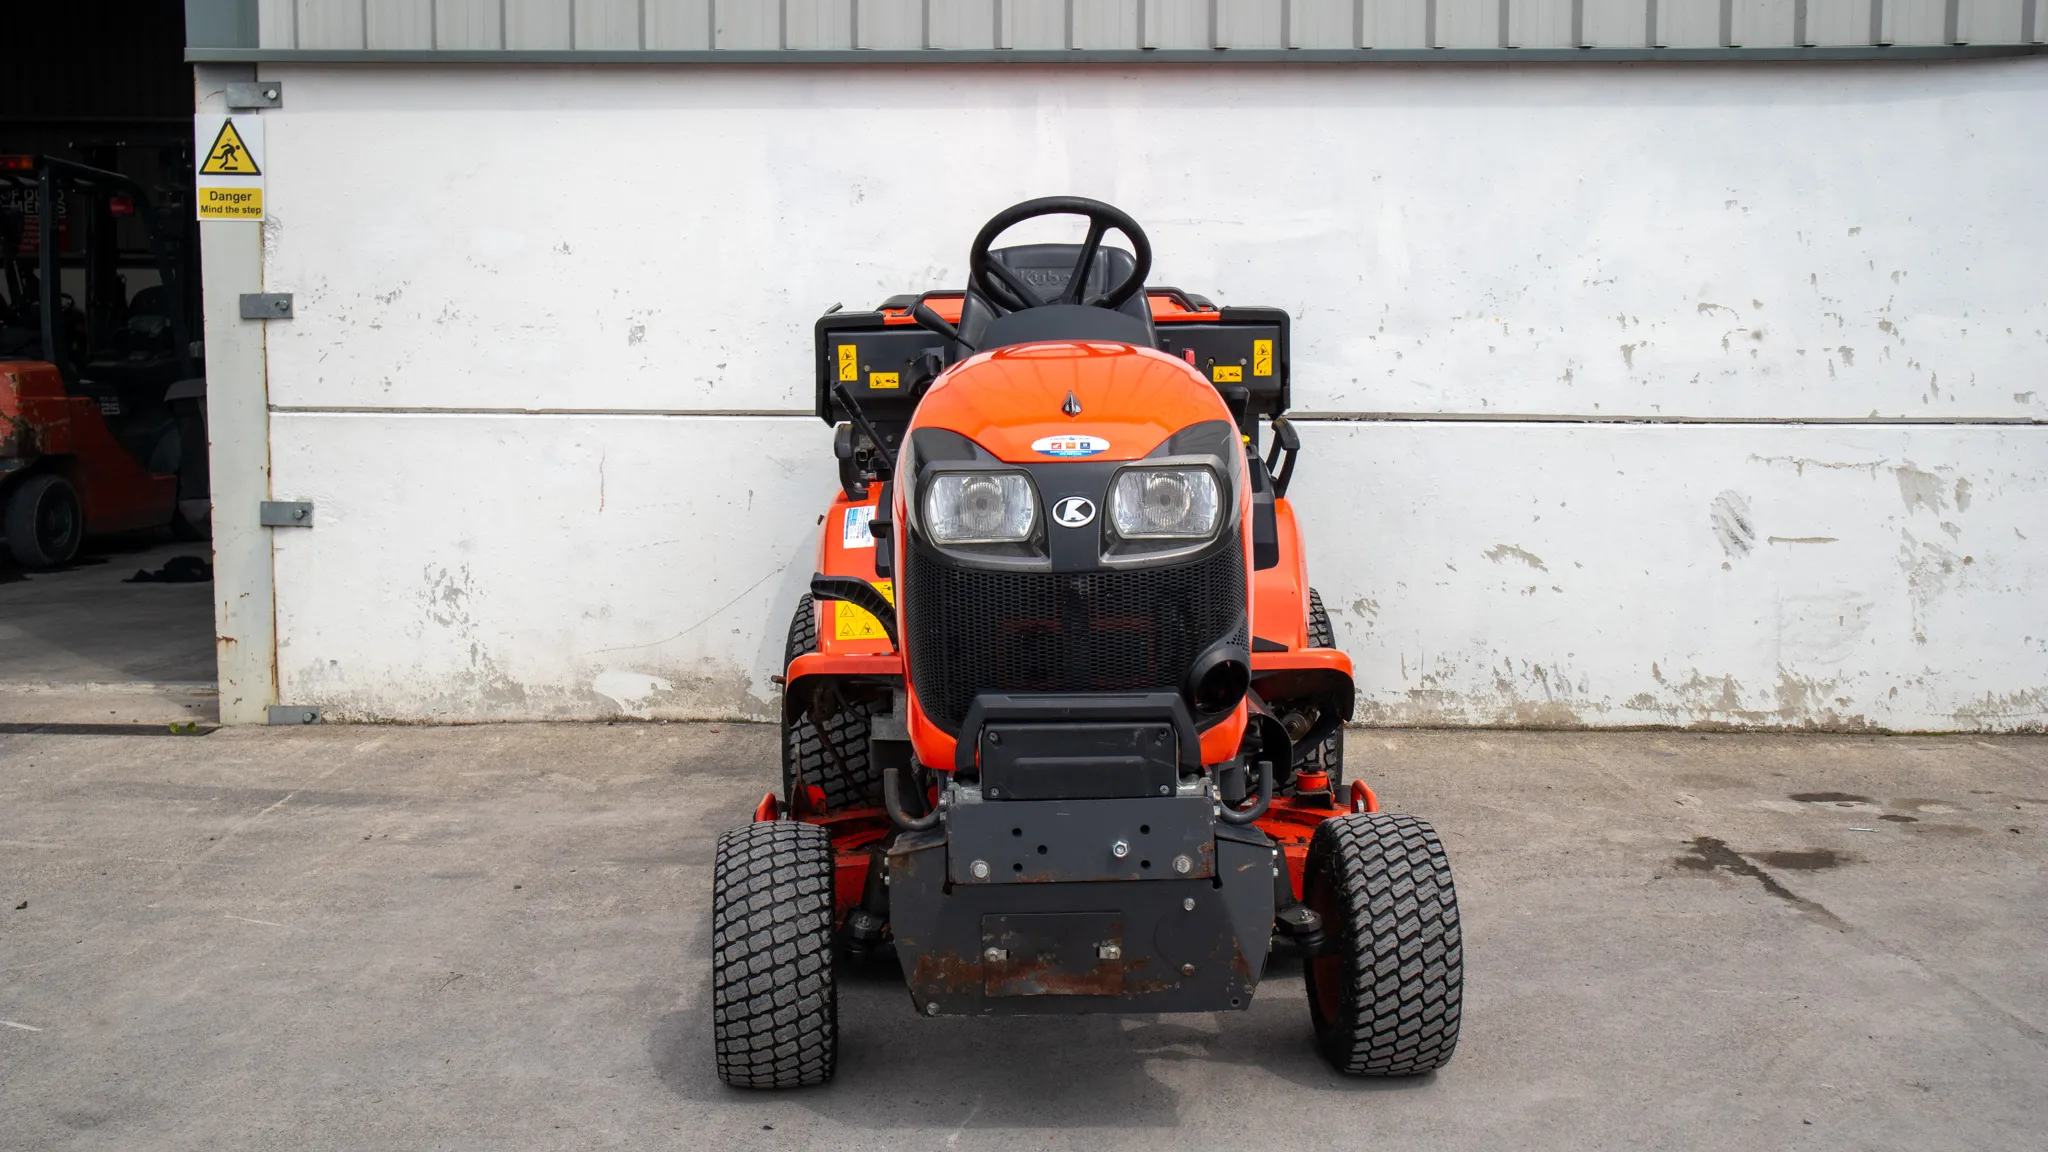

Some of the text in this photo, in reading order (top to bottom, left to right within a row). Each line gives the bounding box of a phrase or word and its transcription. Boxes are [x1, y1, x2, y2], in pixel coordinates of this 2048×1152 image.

[209, 190, 252, 204] Danger
[200, 205, 262, 216] Mind the step
